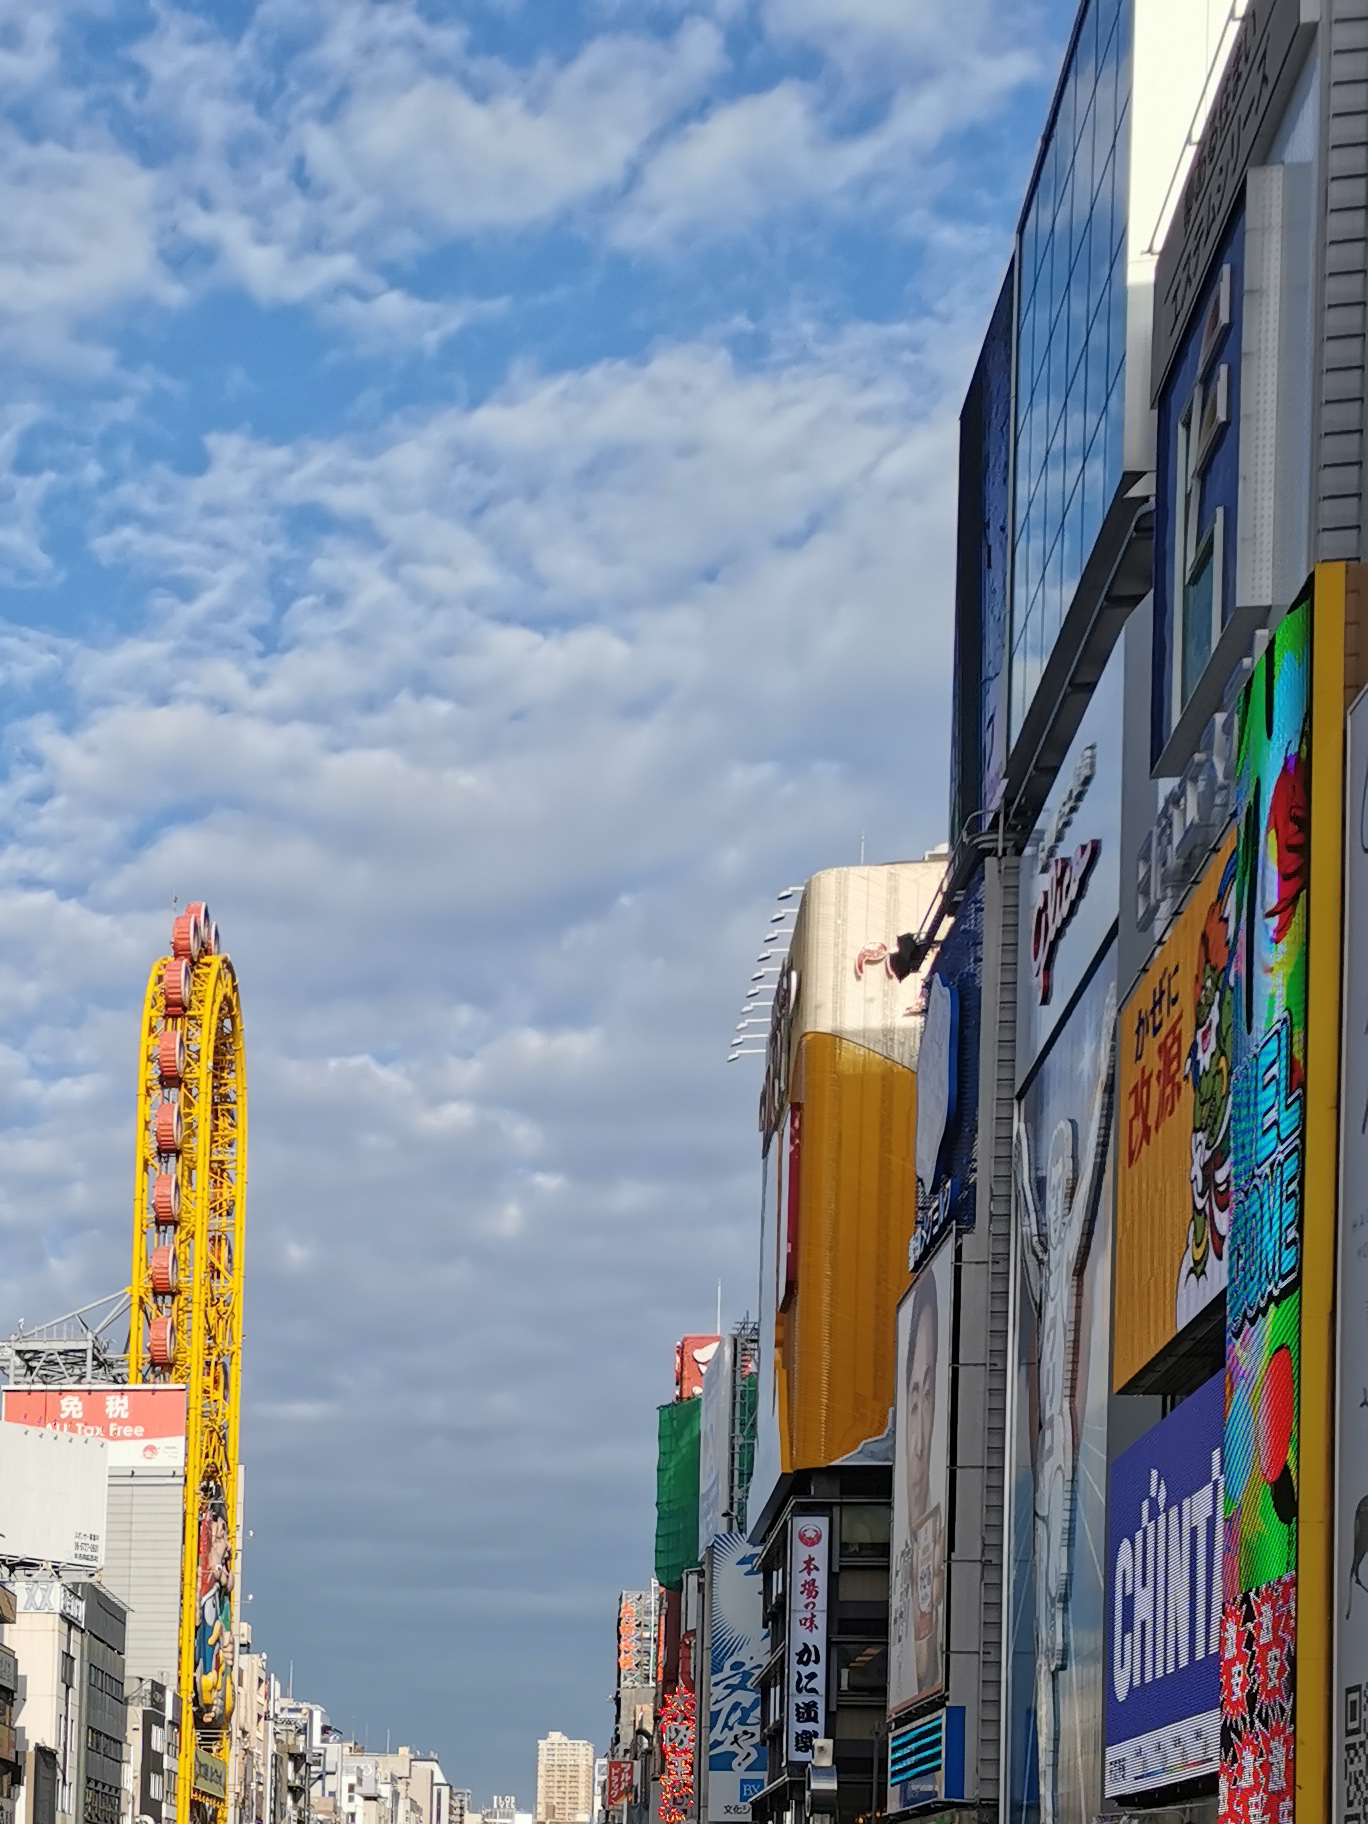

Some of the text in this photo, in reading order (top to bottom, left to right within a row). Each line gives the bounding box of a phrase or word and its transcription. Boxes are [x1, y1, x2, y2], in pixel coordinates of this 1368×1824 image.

[1128, 1009, 1184, 1169] 改源
[59, 1395, 130, 1419] 免税
[109, 1423, 145, 1437] Free
[798, 1553, 821, 1634] 本場の味
[794, 1641, 821, 1753] かに道楽
